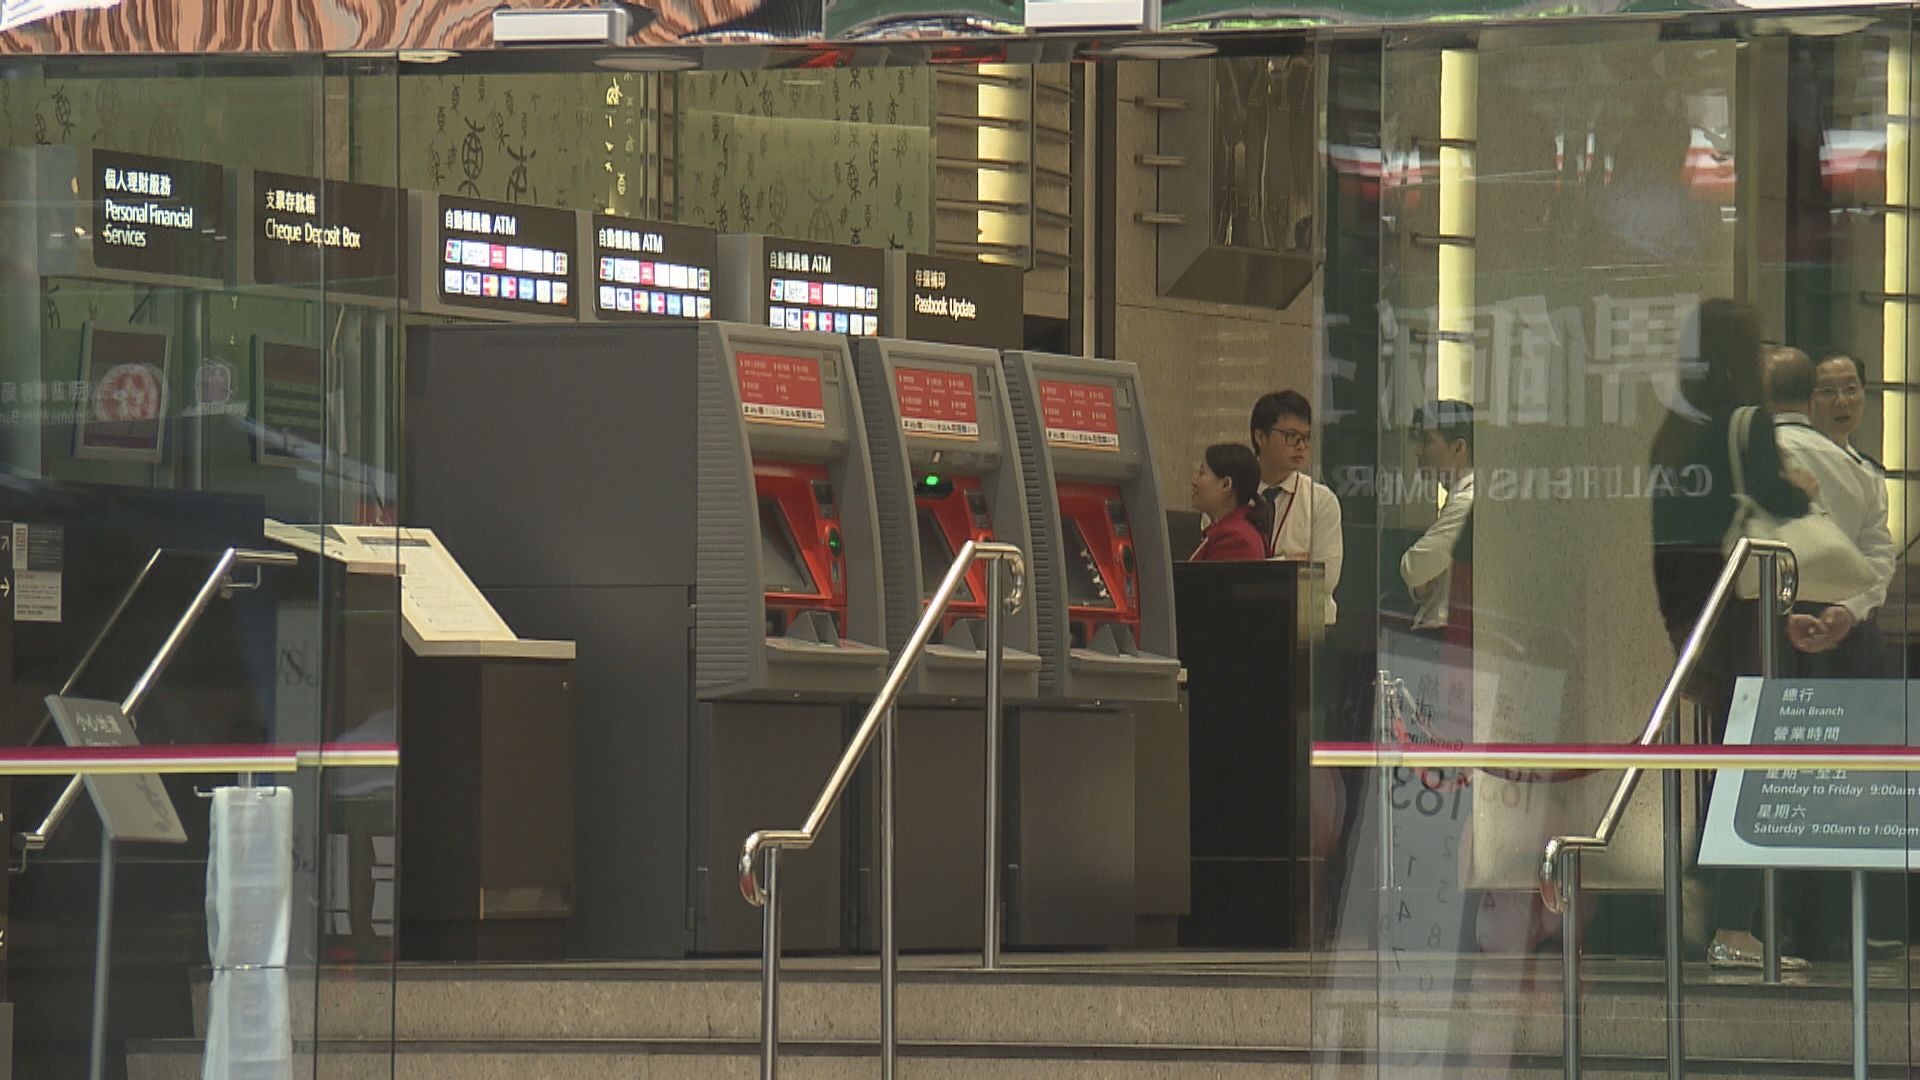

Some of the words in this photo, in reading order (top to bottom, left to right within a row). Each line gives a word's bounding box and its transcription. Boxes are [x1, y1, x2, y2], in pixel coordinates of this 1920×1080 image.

[105, 167, 171, 197] 個人理財服務
[105, 200, 148, 222] Personal
[149, 204, 192, 230] Financial
[493, 214, 516, 236] ATM
[105, 224, 146, 248] Services
[265, 218, 302, 243] Cheque
[304, 224, 341, 249] Deposit
[342, 227, 361, 249] Box
[642, 232, 663, 254] ATM
[811, 255, 831, 274] ATM
[915, 294, 948, 315] Passbook
[949, 298, 976, 321] Update
[1782, 688, 1814, 702] 總行
[1779, 706, 1805, 716] Main
[1809, 706, 1844, 716] Branch
[1773, 726, 1840, 742] 營業時間
[1762, 784, 1809, 796] Monday
[1812, 784, 1825, 795] to
[1828, 784, 1863, 797] Friday
[1870, 784, 1915, 796] 9:00am
[1757, 804, 1806, 818] 星期六
[1753, 822, 1805, 836] Saturday
[1812, 823, 1856, 835] 9:00am
[1858, 824, 1870, 835] to
[1874, 824, 1919, 837] 1:00pm
